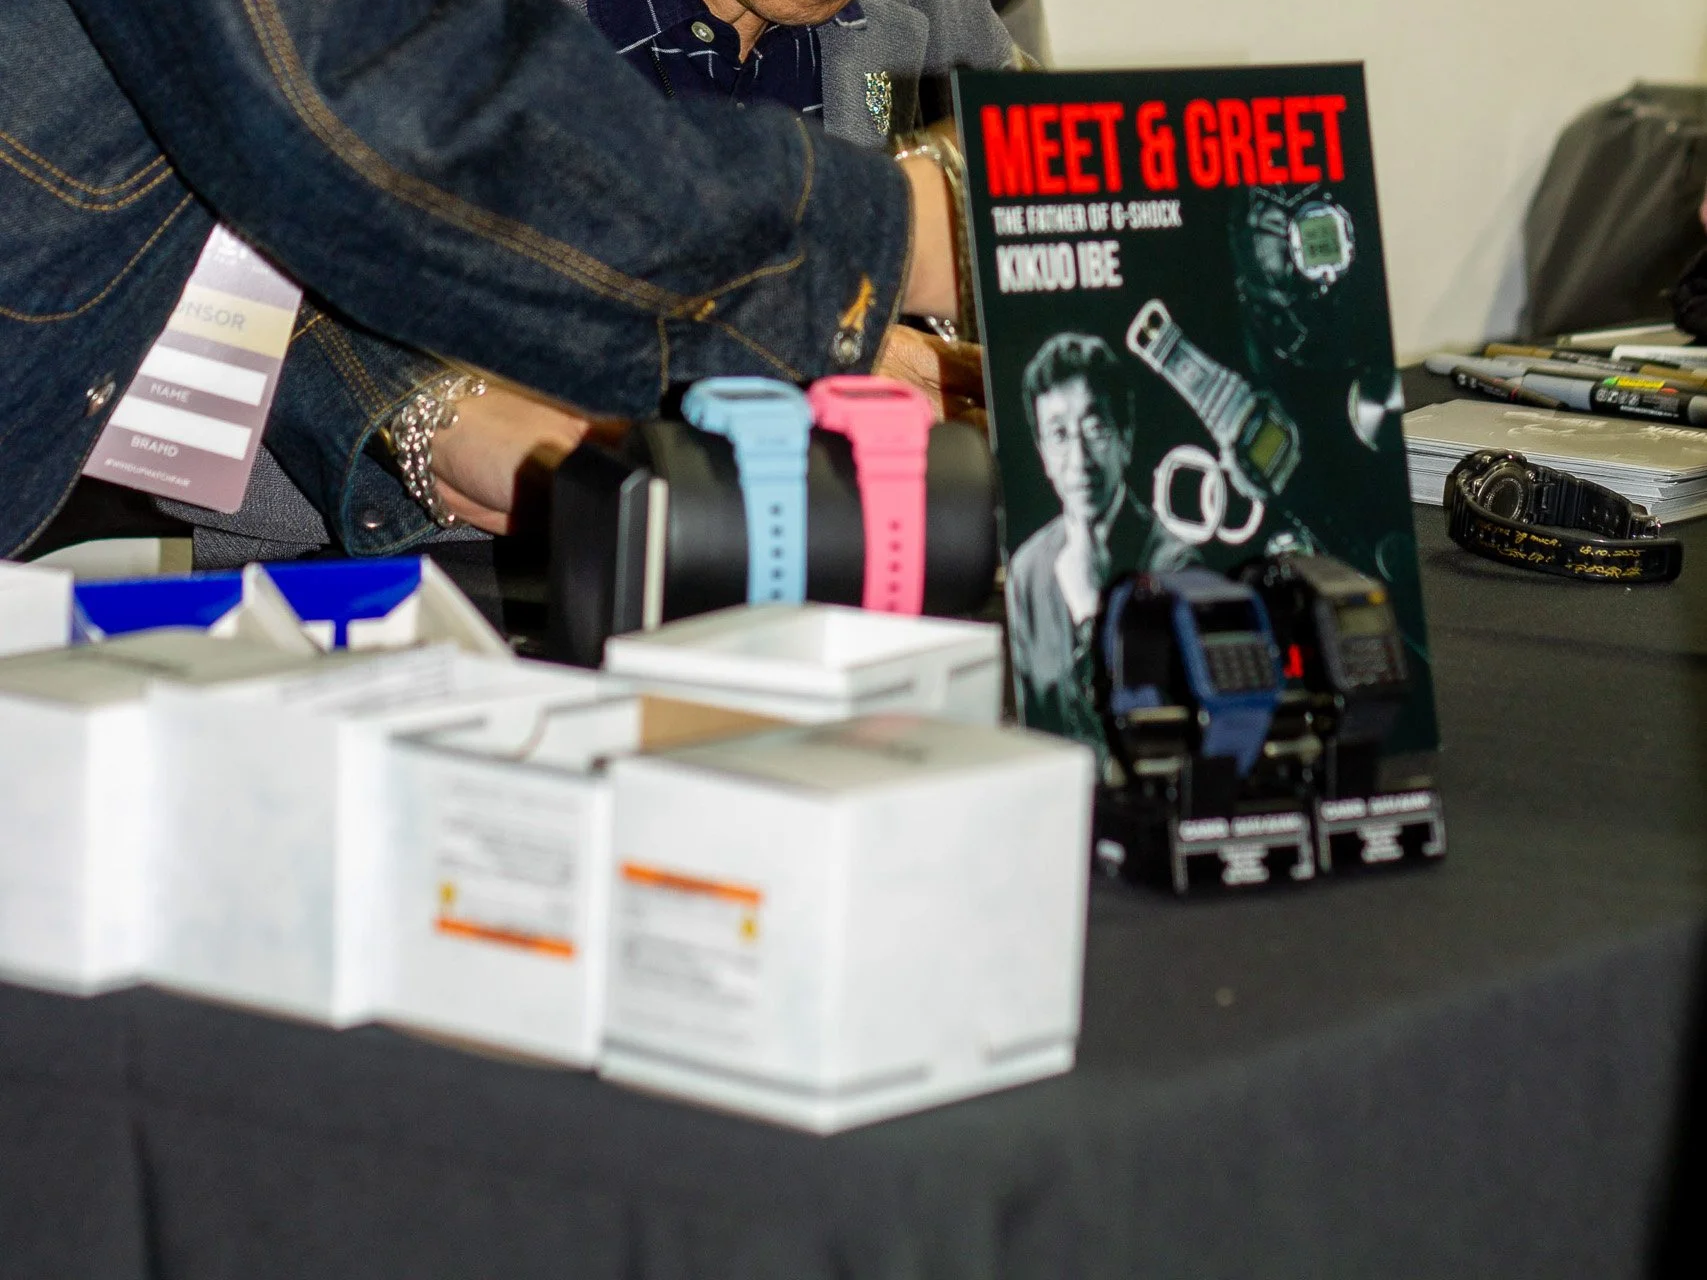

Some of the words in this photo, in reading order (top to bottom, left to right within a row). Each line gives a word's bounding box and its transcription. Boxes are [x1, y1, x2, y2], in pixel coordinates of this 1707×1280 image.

[981, 102, 1124, 197] MEET
[1135, 100, 1179, 191] &
[1183, 94, 1347, 189] GREET
[991, 205, 1026, 236] THE
[1026, 203, 1088, 235] FATHER
[1088, 201, 1109, 232] OF
[1111, 199, 1183, 231] G-SHOCK
[996, 242, 1077, 294] KIKUO
[1077, 240, 1123, 289] IBE
[180, 300, 246, 331] NSOR
[150, 383, 191, 403] NAME
[131, 435, 179, 458] BRAND
